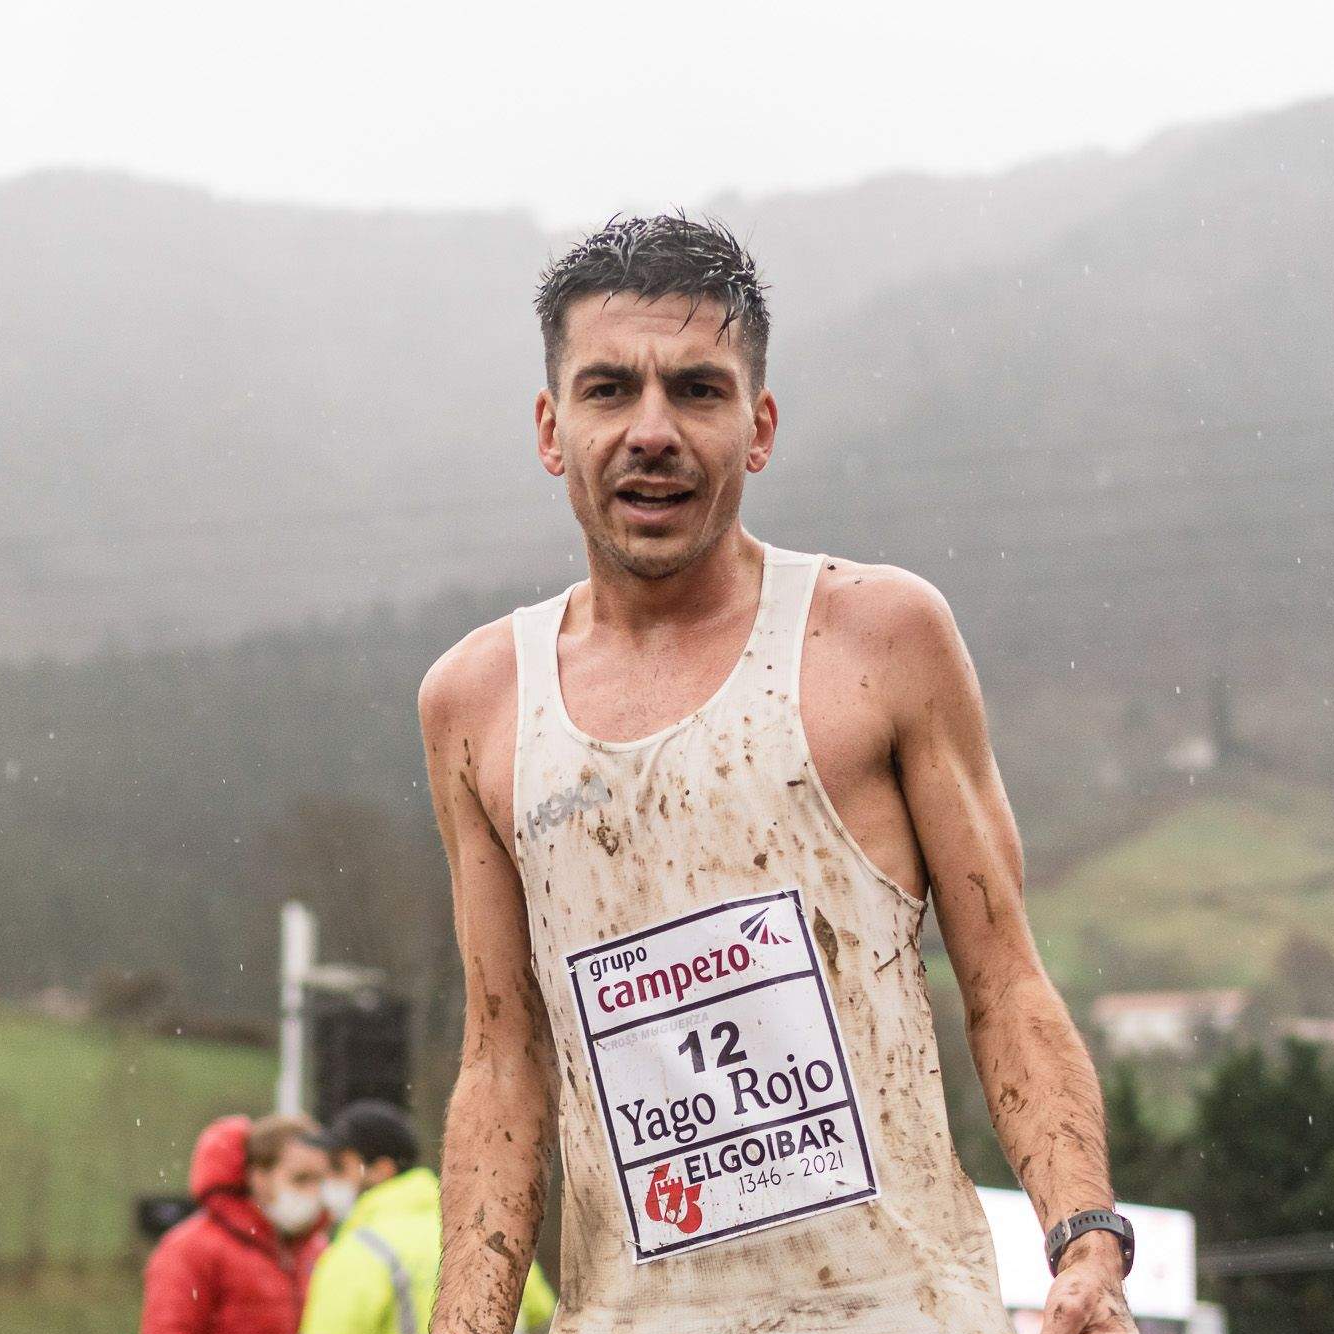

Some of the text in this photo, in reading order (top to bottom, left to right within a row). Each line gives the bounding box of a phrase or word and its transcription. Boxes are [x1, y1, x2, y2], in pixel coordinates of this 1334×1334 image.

[525, 774, 612, 841] HOKA
[589, 946, 648, 982] grupo
[597, 943, 750, 1013] campezo
[603, 1012, 710, 1052] CROSS MUGUERZA
[677, 1021, 748, 1073] 12
[616, 1053, 833, 1146] Yago Rojo
[684, 1118, 845, 1185] ELGOIBAR
[739, 1166, 782, 1194] 1346
[799, 1150, 844, 1178] 2021
